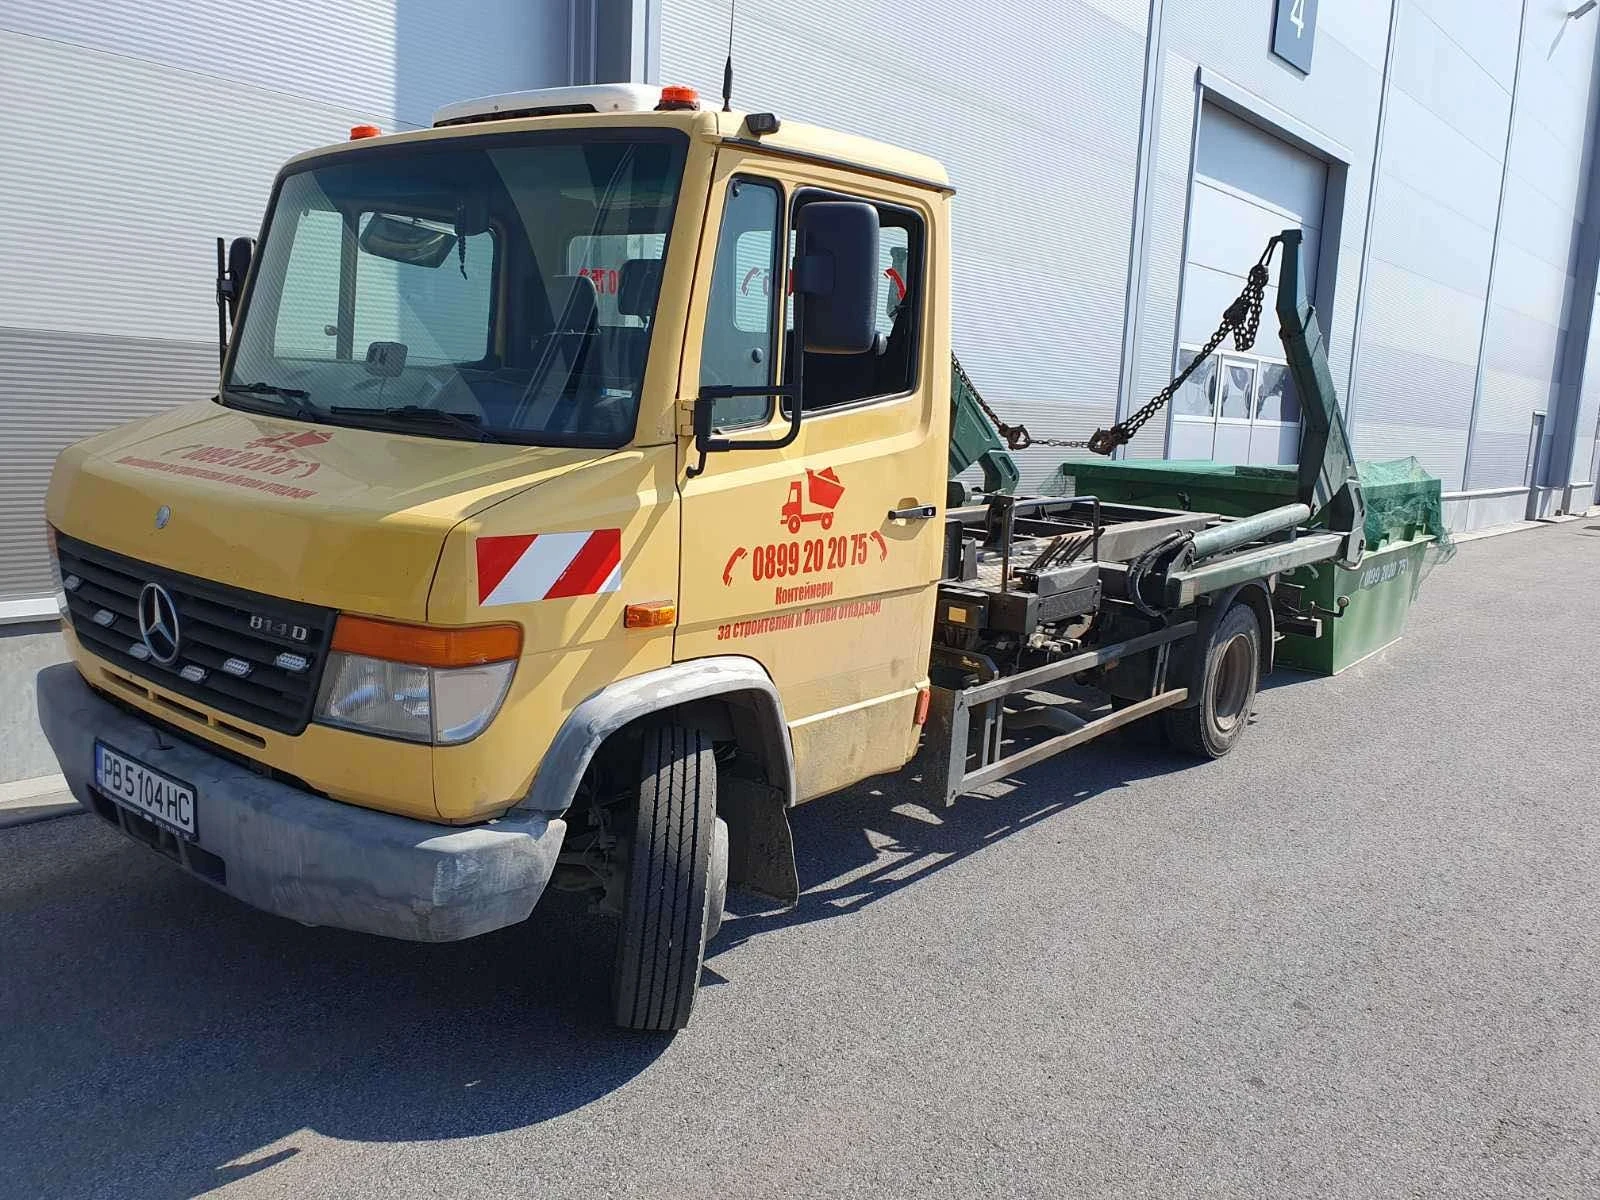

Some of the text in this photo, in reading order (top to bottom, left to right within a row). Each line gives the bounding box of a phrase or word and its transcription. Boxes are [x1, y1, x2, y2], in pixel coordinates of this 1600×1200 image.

[1290, 0, 1305, 39] 4
[752, 533, 868, 581] 0899 20 20 75
[775, 581, 833, 605] Контейнери
[717, 624, 731, 641] за
[733, 612, 794, 639] строителни
[803, 607, 837, 626] битови
